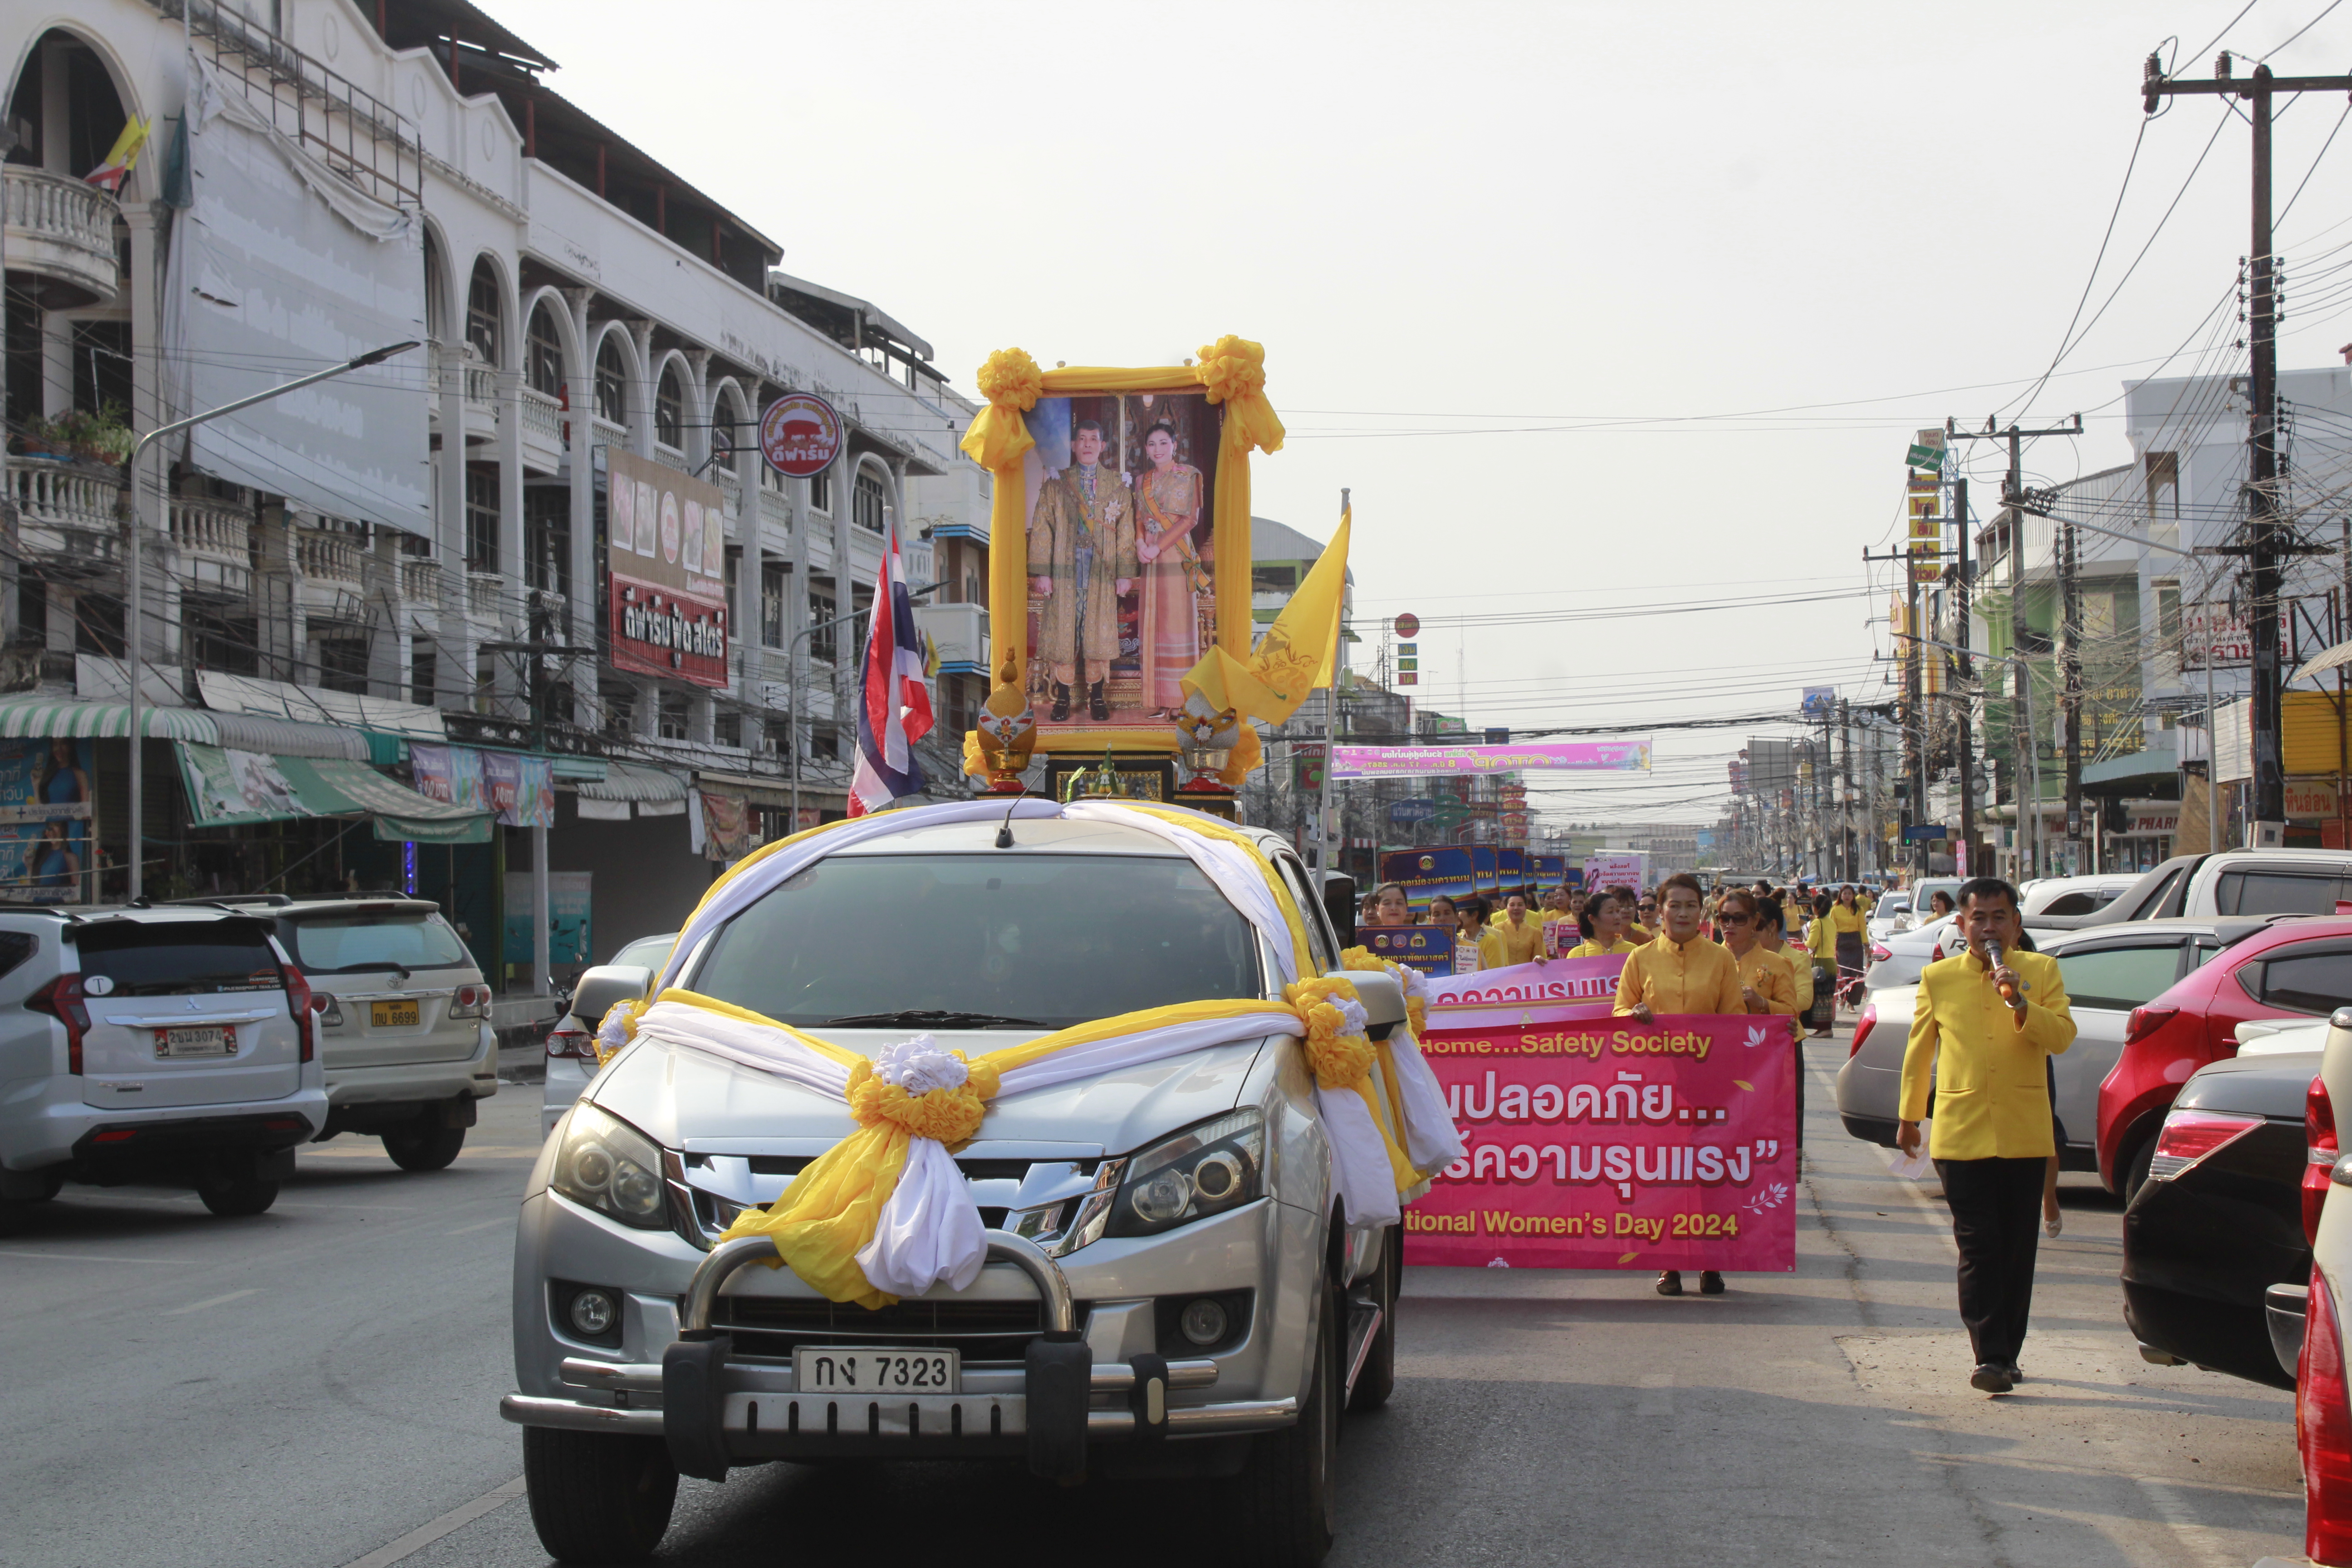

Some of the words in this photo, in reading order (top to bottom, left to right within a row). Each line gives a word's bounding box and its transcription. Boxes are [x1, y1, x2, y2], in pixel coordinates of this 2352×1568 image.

[772, 444, 829, 462] ดีฟาร์ม
[93, 978, 104, 993] T
[392, 1011, 416, 1024] 6699
[195, 1030, 221, 1042] 3074
[1612, 1030, 1712, 1058] Society
[1615, 1213, 1665, 1241] Day
[1672, 1214, 1739, 1236] 2024
[875, 1357, 947, 1387] 7323
